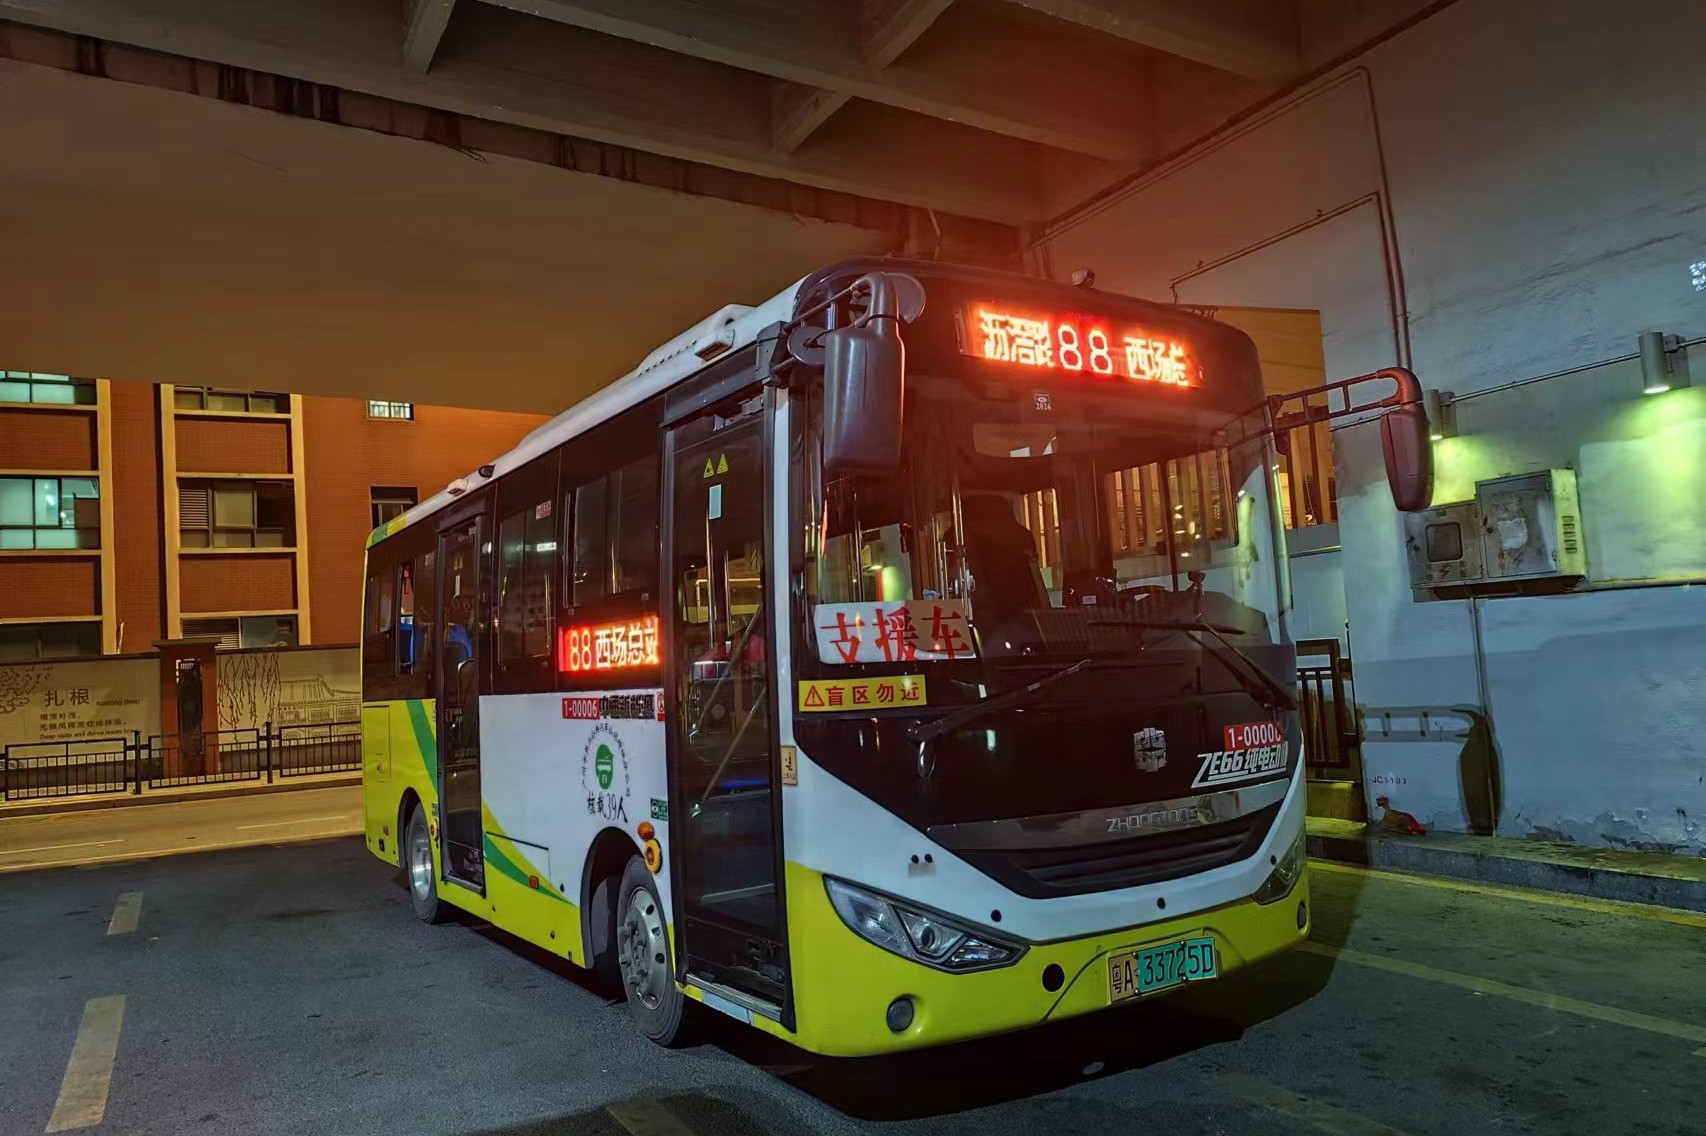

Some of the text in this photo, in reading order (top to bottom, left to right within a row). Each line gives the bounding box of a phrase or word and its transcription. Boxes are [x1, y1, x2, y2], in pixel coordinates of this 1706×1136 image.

[1058, 324, 1112, 374] 88
[570, 629, 591, 671] 88
[820, 606, 970, 663] 支援车
[44, 688, 90, 707] 扎根
[563, 700, 598, 717] 1-00006
[825, 684, 920, 706] 盲区勿近
[1143, 943, 1214, 986] 33725D
